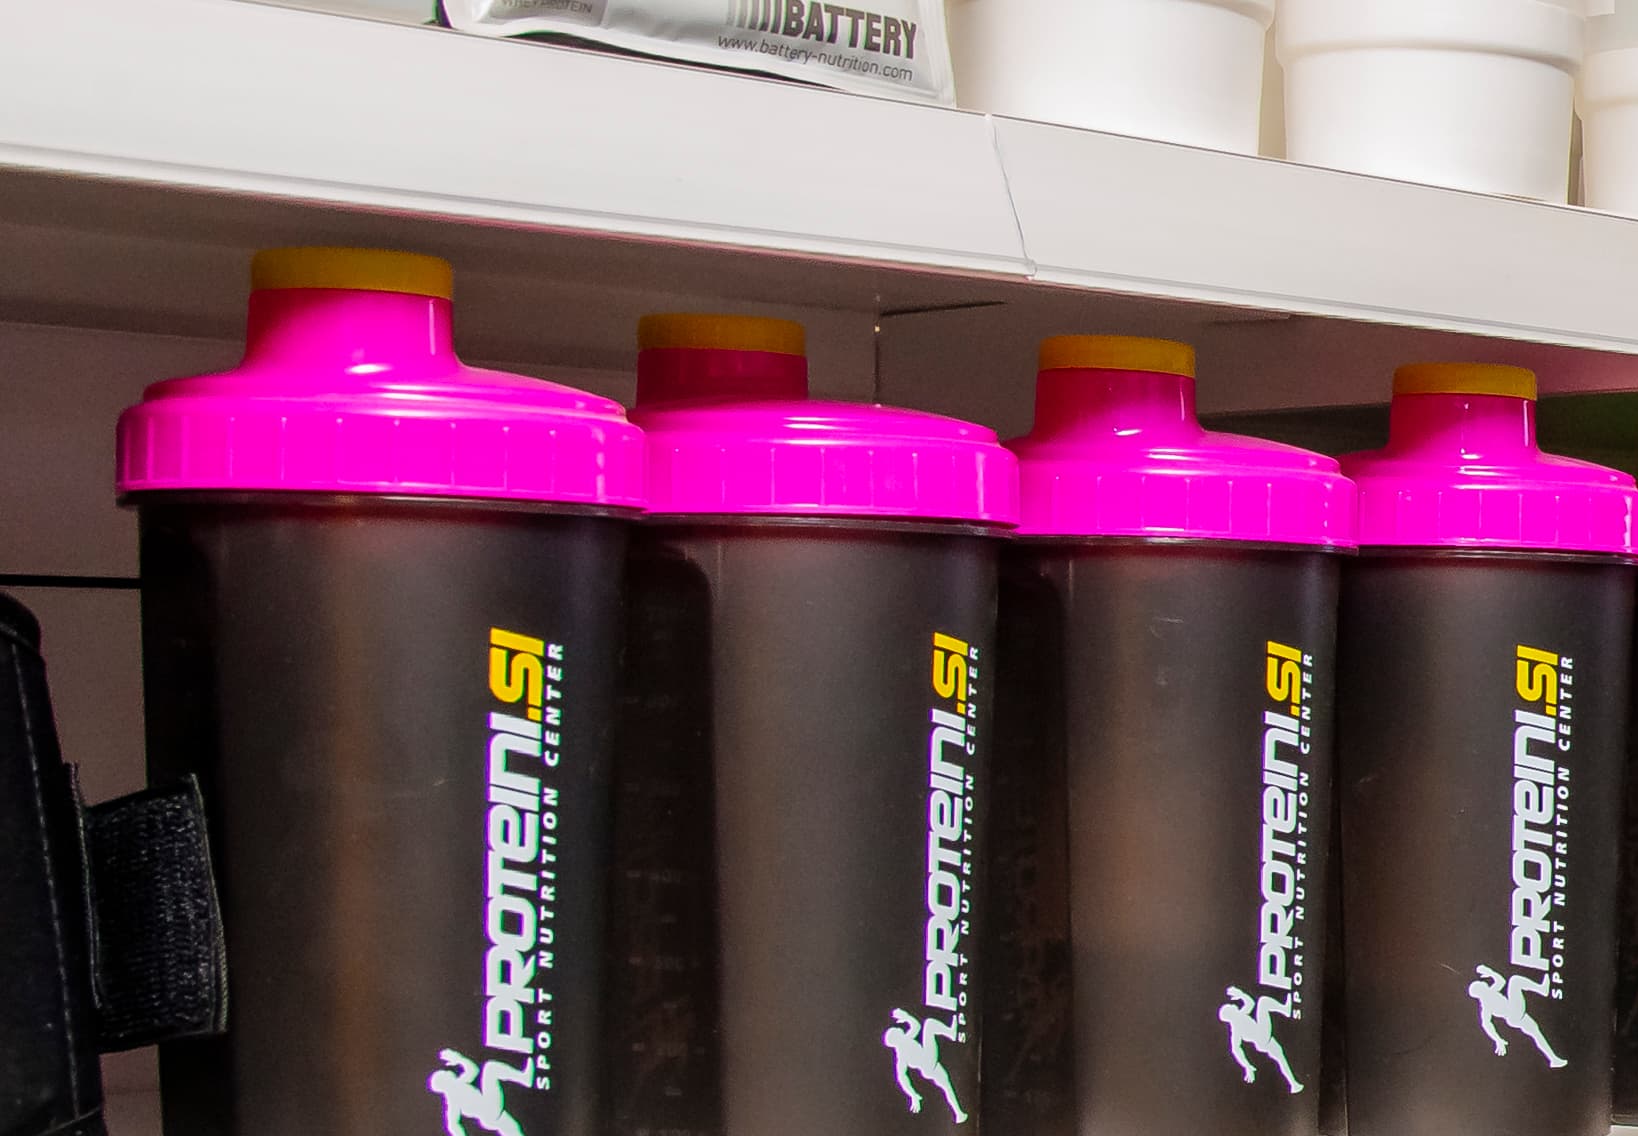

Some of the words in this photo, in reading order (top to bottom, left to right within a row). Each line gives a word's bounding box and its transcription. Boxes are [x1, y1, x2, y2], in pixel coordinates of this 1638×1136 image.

[717, 33, 913, 81] www.battery-nutrition.com
[783, 0, 917, 59] BATTERY
[544, 642, 565, 767] CENTER
[966, 646, 979, 756] CENTER
[1300, 653, 1313, 755] CENTER
[1558, 656, 1574, 751] CENTER
[539, 788, 559, 969] NUTRITION
[960, 775, 974, 935] NUTRITION
[1295, 772, 1309, 920] NUTRITION
[1555, 767, 1570, 906] NUTRITION
[957, 953, 968, 1044] SPORT
[1292, 937, 1304, 1019] SPORT
[1551, 921, 1565, 1000] SPORT
[537, 988, 553, 1090] SPORT
